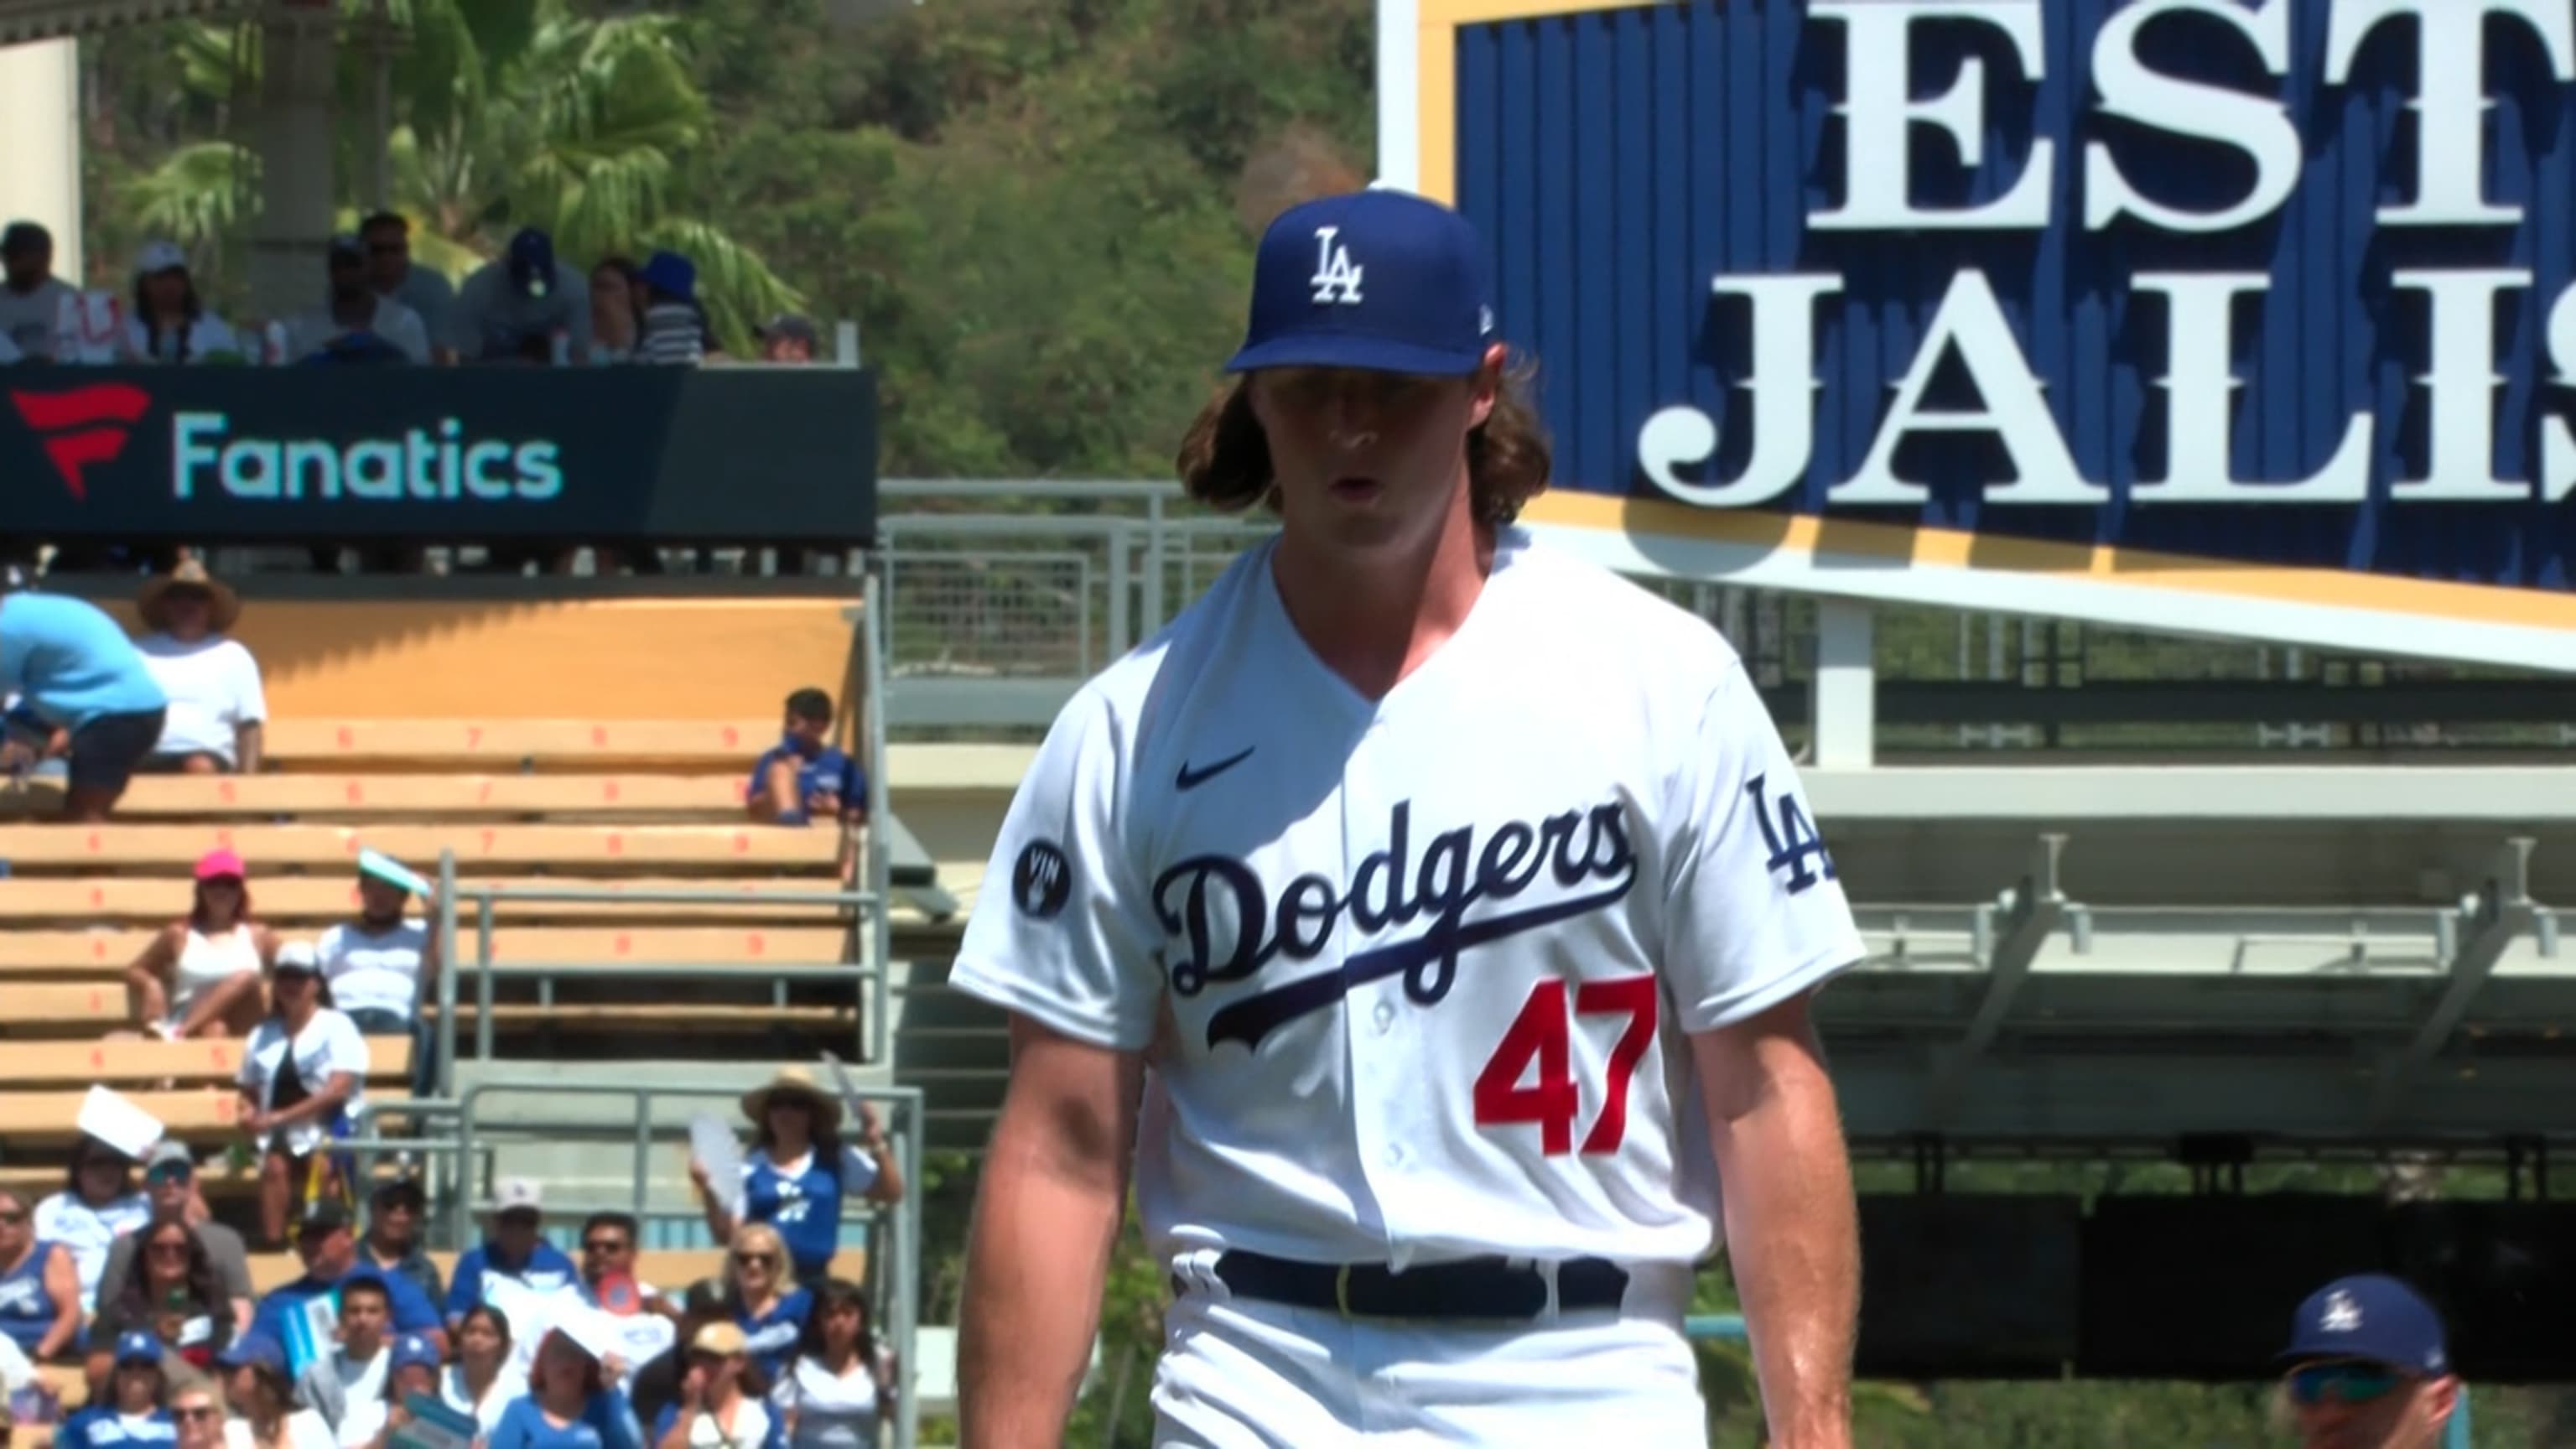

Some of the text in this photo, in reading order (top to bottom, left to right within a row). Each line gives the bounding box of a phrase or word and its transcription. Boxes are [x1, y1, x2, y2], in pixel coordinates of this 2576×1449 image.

[1310, 226, 1363, 303] LA
[1639, 267, 2576, 506] JALI
[173, 410, 564, 501] Fanatics
[1029, 847, 1061, 886] VIN
[1745, 771, 1836, 895] LA
[1153, 797, 1639, 1005] Dodgers
[1474, 975, 1656, 1156] 47
